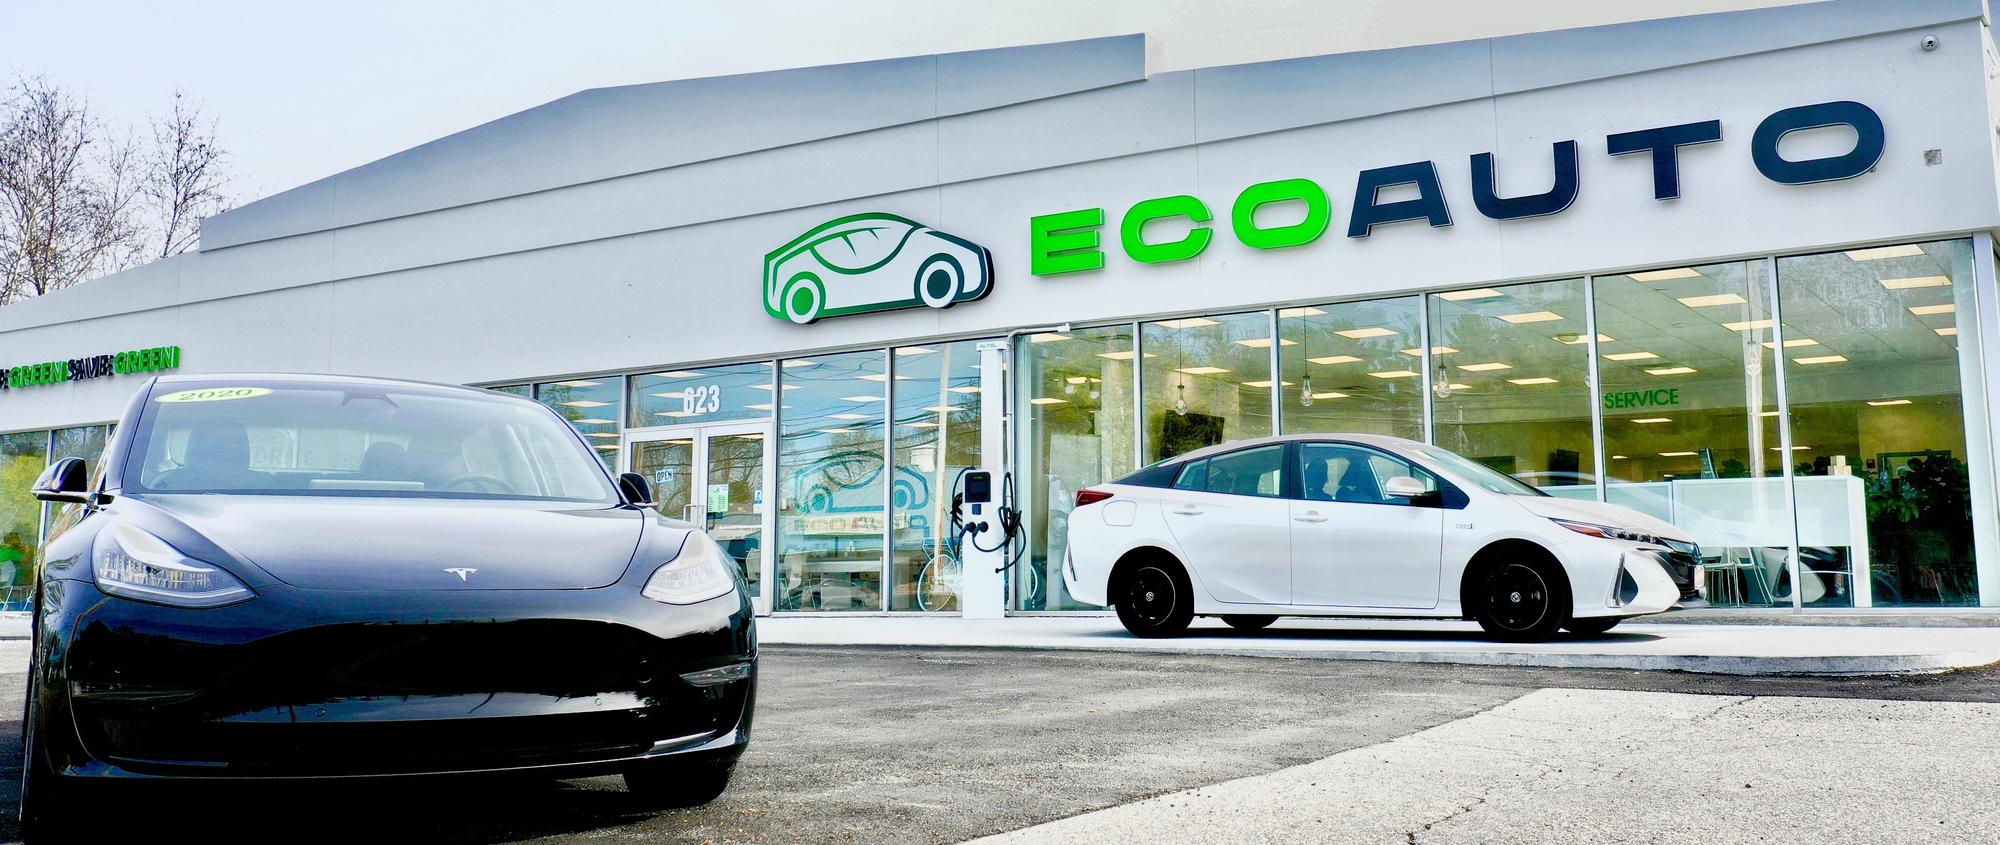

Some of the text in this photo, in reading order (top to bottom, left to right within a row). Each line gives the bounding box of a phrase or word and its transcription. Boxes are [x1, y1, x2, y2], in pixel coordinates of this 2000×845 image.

[9, 361, 68, 388] GREEN
[67, 354, 114, 381] SAVE
[114, 345, 180, 375] GREEN
[179, 388, 253, 401] 2020
[683, 385, 720, 414] 623
[1604, 388, 1680, 409] SERVICE
[657, 471, 673, 483] OPEN
